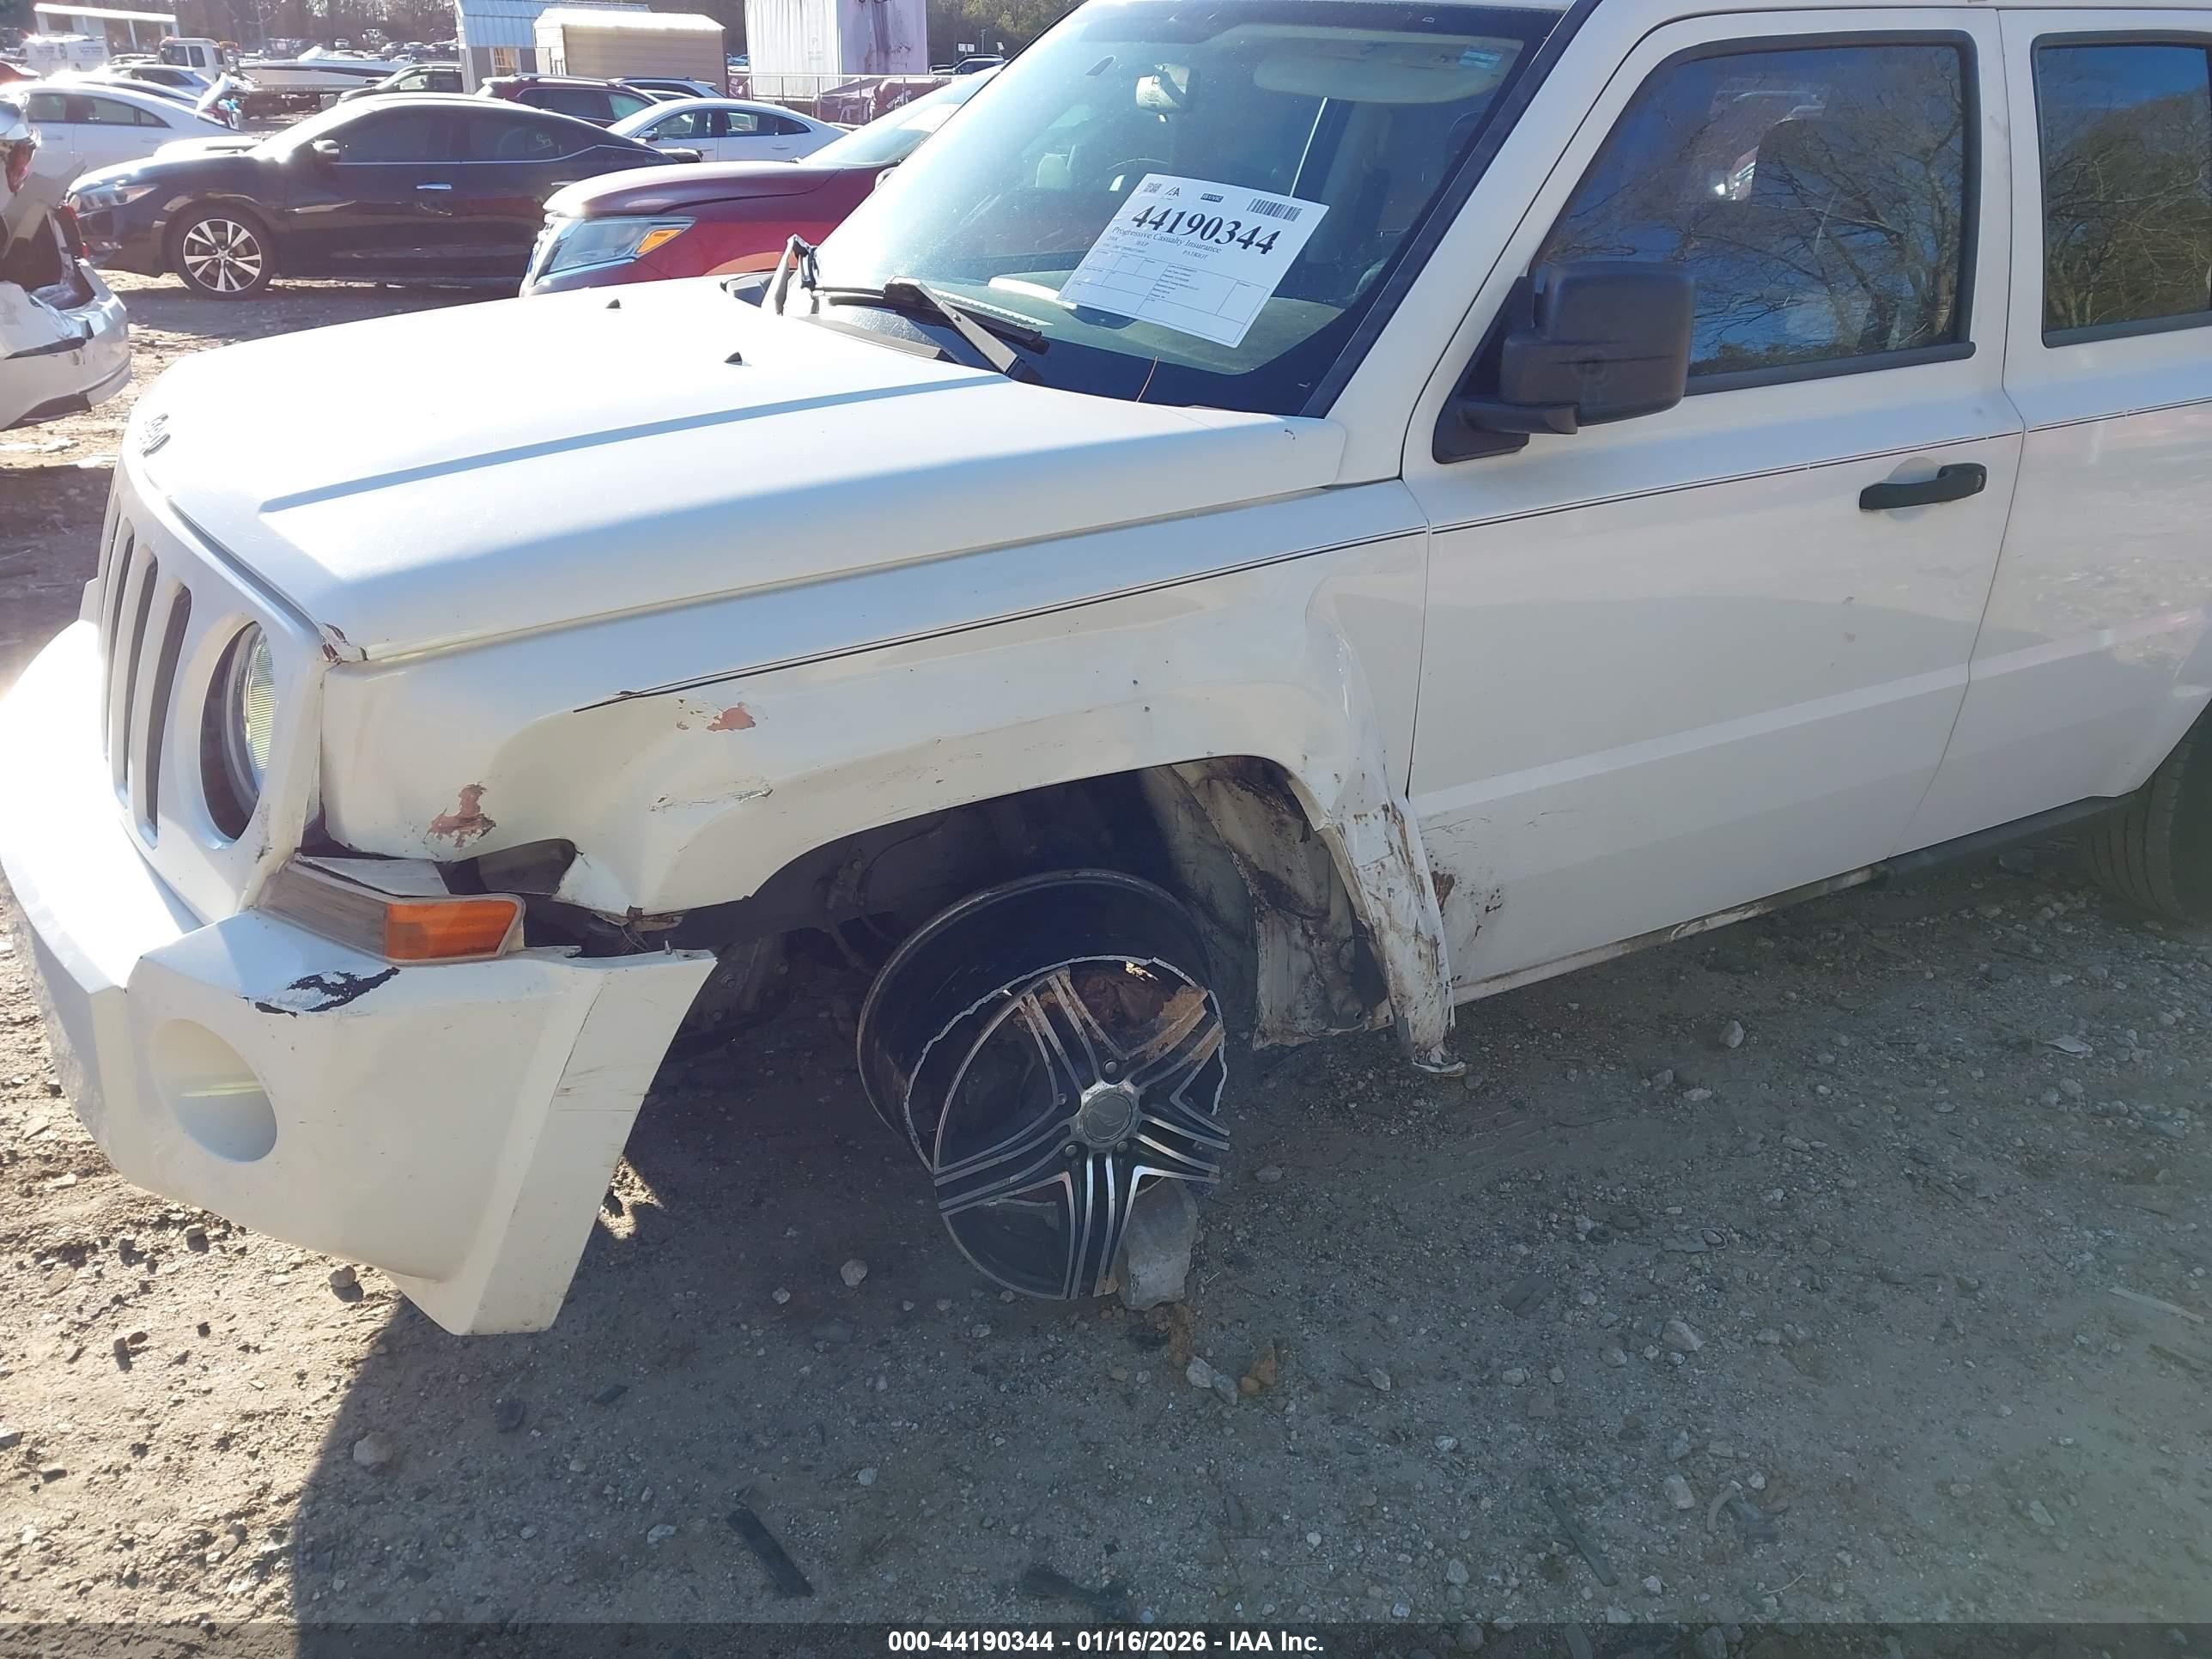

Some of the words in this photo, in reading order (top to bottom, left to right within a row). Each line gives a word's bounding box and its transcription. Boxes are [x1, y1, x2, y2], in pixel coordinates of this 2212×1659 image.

[1112, 226, 1152, 240] Progressive
[1152, 233, 1184, 246] Casualty
[1185, 240, 1222, 254] Insurance
[1132, 205, 1282, 255] 44190344
[1182, 250, 1210, 260] PATRIOT
